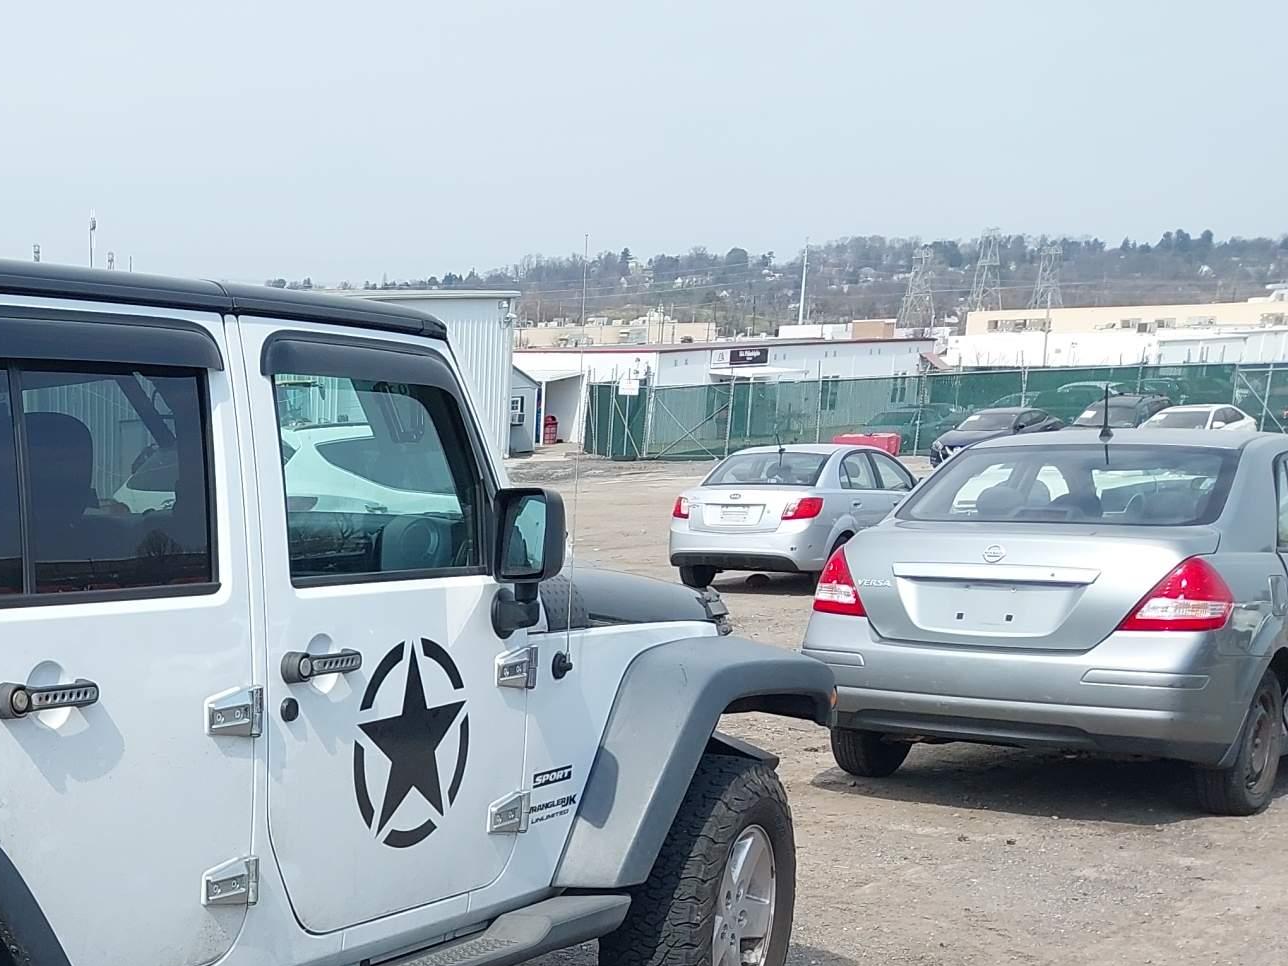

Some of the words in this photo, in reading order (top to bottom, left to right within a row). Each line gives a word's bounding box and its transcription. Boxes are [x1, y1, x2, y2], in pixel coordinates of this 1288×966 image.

[858, 579, 891, 588] VERSA
[534, 769, 571, 785] SPORT
[530, 808, 569, 824] UNLIMITED
